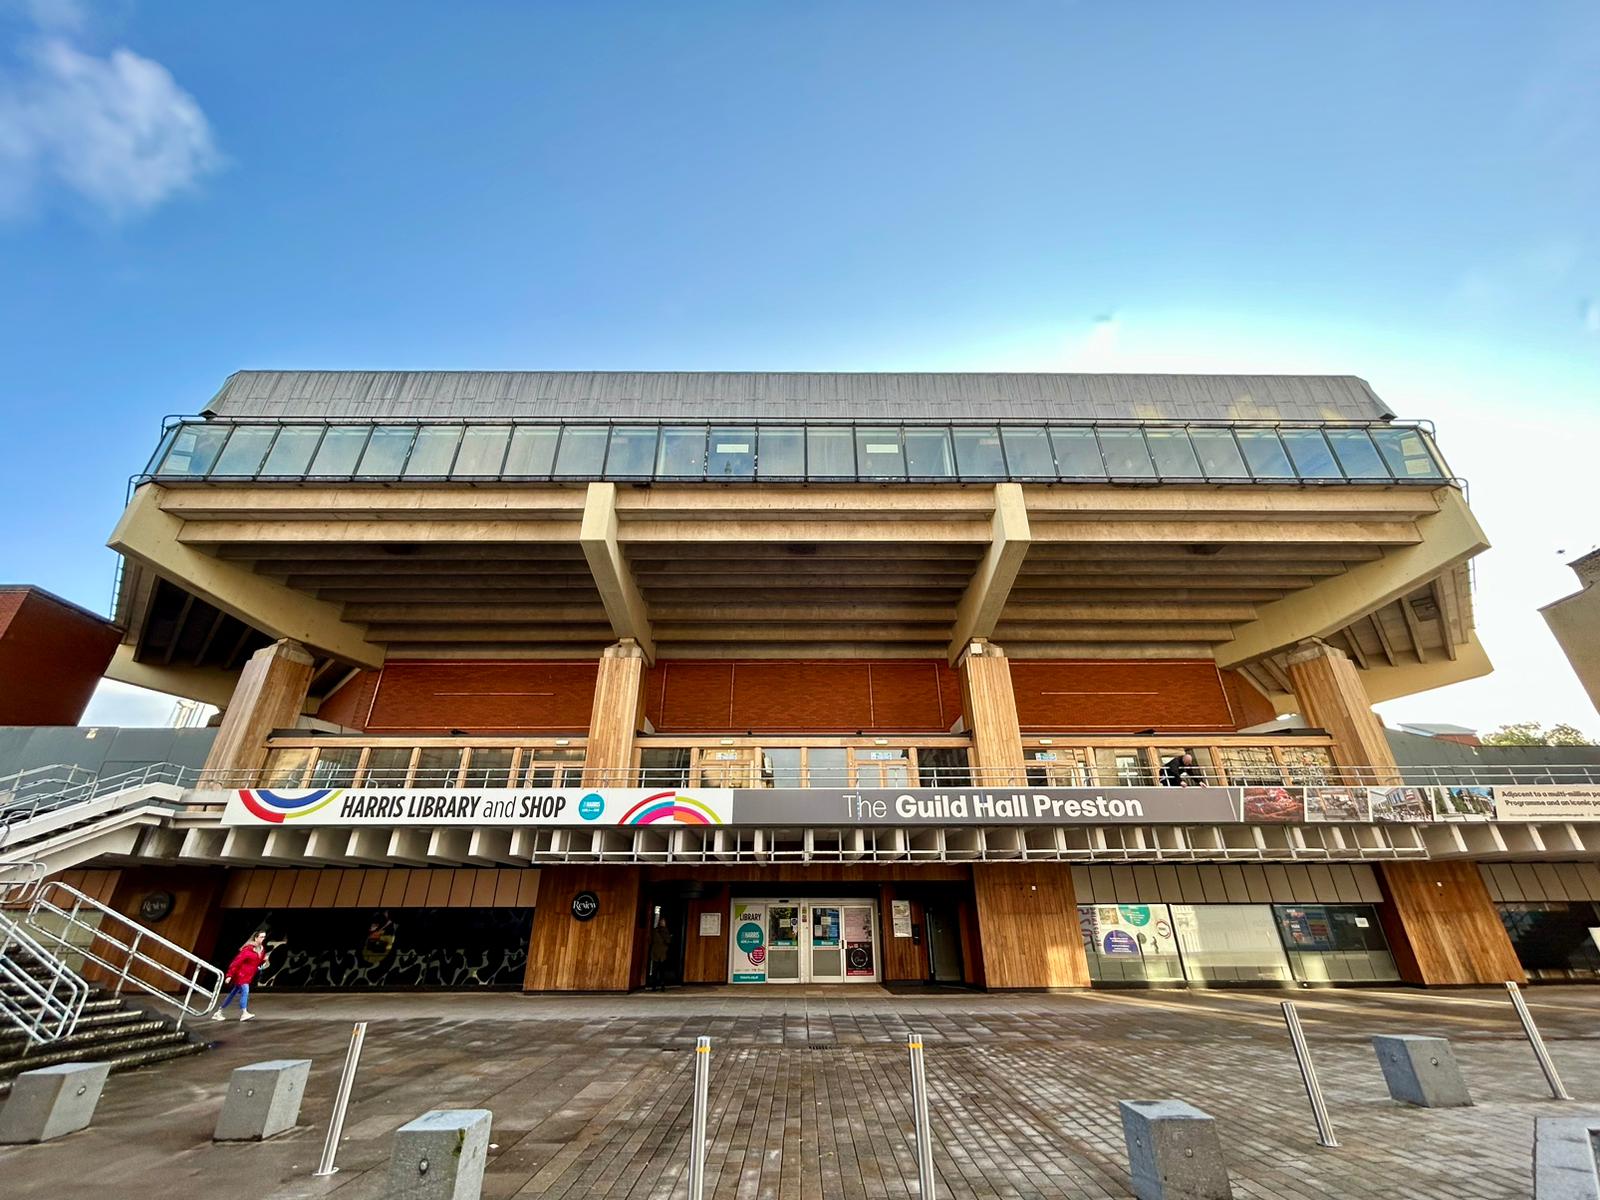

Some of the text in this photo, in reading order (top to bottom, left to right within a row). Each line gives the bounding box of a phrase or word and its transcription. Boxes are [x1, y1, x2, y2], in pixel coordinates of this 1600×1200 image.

[340, 796, 566, 818] HARRIS LIBRARY and SHOP
[842, 794, 1144, 818] The Guild Hall Preston
[1504, 799, 1546, 807] Programme
[739, 913, 761, 921] LIBRARY
